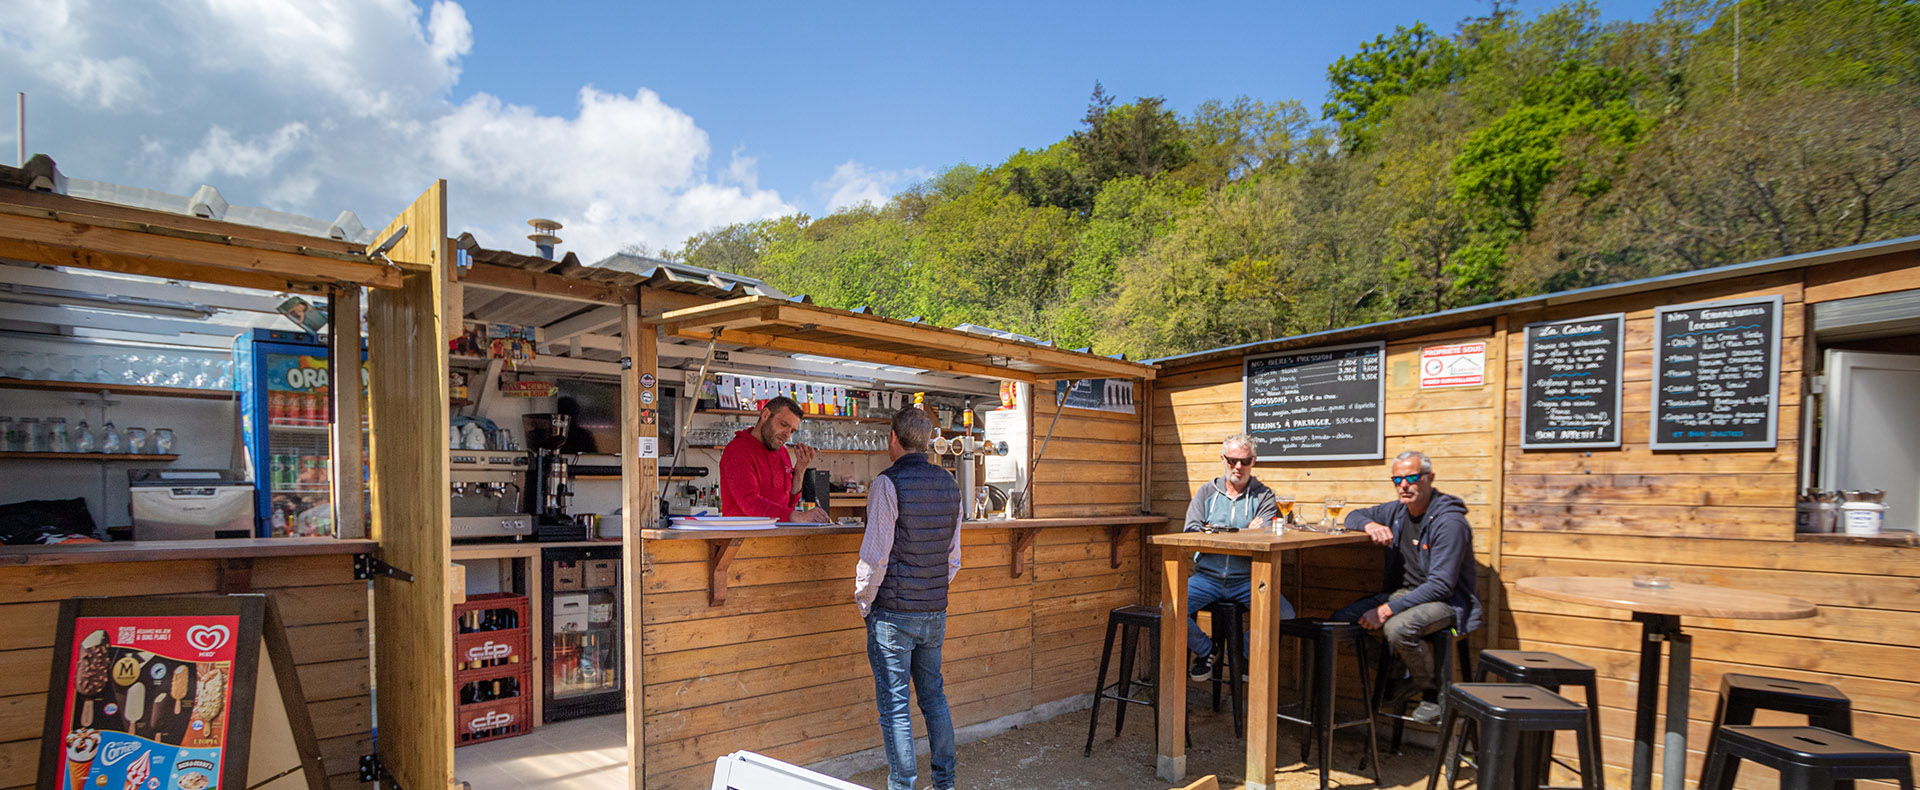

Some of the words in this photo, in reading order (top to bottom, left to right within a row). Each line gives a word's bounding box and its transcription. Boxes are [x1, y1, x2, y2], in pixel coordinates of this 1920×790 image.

[1667, 312, 1690, 322] Nos
[1538, 326, 1559, 336] La
[1562, 325, 1603, 335] Cabane
[1251, 360, 1265, 368] NOS
[1296, 352, 1333, 363] PRESSION
[1293, 419, 1332, 427] PARTAGER
[469, 641, 508, 659] cfp
[119, 662, 134, 677] M
[471, 711, 510, 728] cfp
